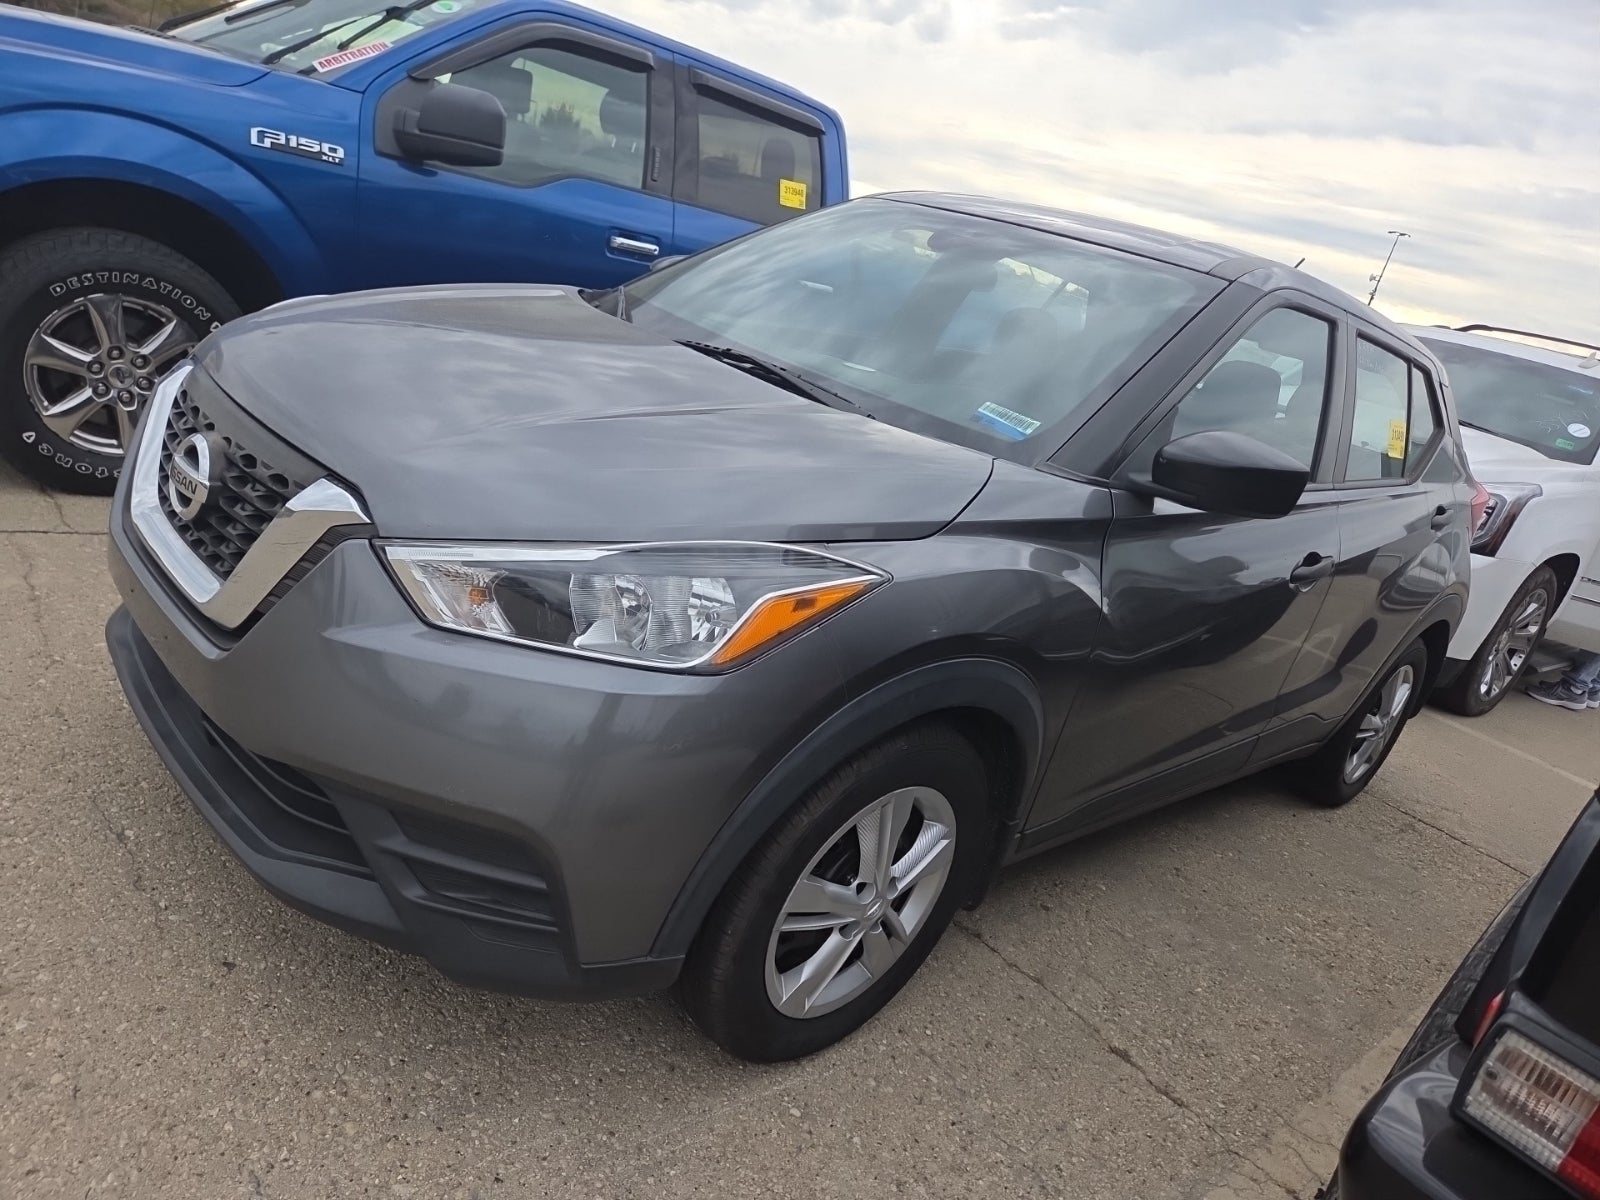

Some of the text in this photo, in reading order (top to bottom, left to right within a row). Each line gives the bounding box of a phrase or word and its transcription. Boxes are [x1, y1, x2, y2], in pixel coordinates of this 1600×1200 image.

[318, 42, 389, 70] ARBITRATION
[250, 127, 345, 158] F150
[321, 154, 341, 163] XLT
[50, 272, 211, 320] DESTINATION
[171, 465, 198, 495] SSAN
